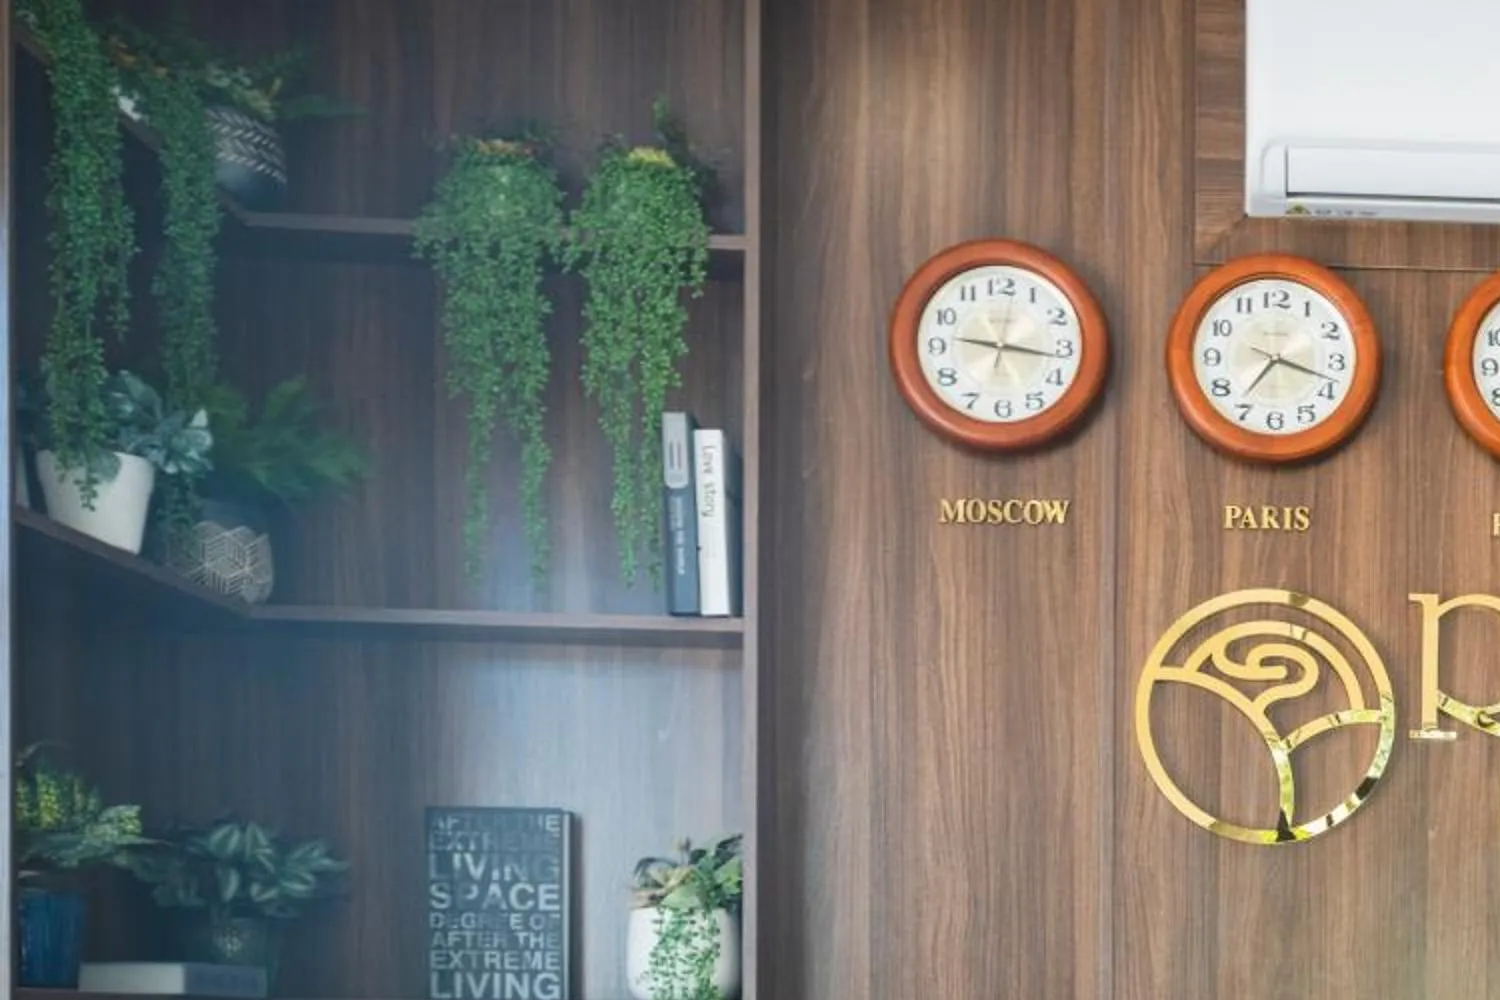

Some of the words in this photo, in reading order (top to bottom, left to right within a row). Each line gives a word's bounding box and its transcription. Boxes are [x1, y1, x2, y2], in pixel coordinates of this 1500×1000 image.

[961, 285, 977, 301] 11
[987, 279, 1015, 296] 12
[1029, 288, 1037, 303] 1
[1237, 298, 1252, 313] 11
[1264, 291, 1291, 308] 12
[937, 308, 957, 325] 10
[1047, 308, 1068, 325] 2
[1304, 301, 1311, 317] 1
[1213, 319, 1232, 337] 10
[1321, 322, 1340, 340] 2
[928, 337, 946, 354] 9
[1056, 340, 1073, 357] 3
[1203, 349, 1221, 366] 9
[1328, 353, 1345, 371] 3
[1481, 358, 1499, 376] 9
[938, 368, 957, 386] 8
[1046, 369, 1063, 386] 4
[1212, 379, 1231, 397] 8
[1318, 383, 1334, 400] 4
[963, 393, 979, 409] 7
[1026, 392, 1044, 409] 5
[994, 401, 1012, 418] 6
[1235, 404, 1253, 421] 7
[1298, 404, 1315, 422] 5
[1266, 412, 1284, 430] 6
[939, 498, 1071, 525] MOSCOW
[1223, 505, 1311, 531] PARIS
[429, 853, 560, 881] LIVING
[429, 882, 560, 911] SPACE
[432, 931, 508, 948] AFTER
[515, 932, 560, 949] THE
[430, 950, 560, 971] EXTREME
[430, 973, 560, 1000] LIVING
